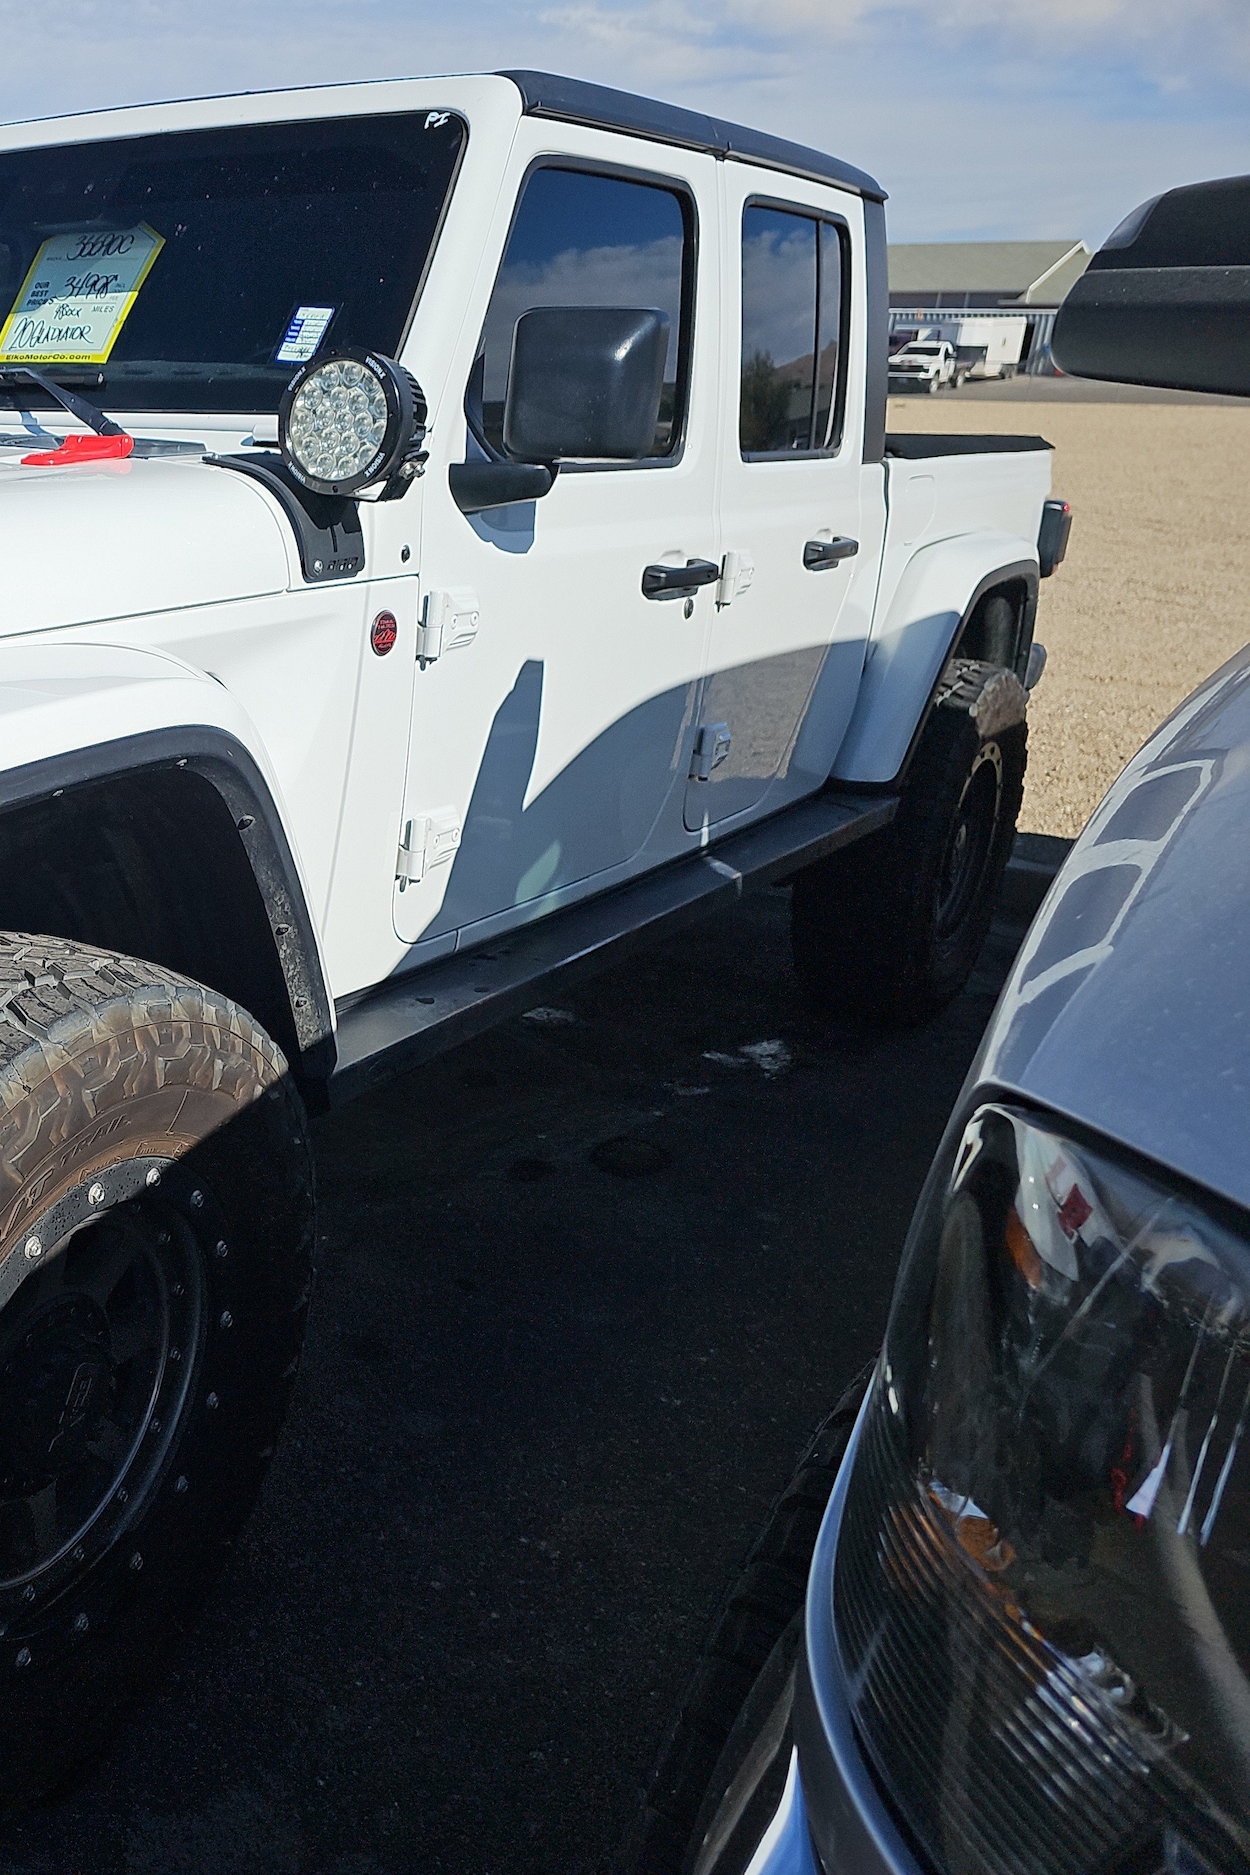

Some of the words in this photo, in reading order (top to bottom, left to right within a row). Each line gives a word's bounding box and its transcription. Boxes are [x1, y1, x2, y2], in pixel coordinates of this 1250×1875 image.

[35, 281, 50, 289] OUR
[30, 290, 50, 298] BEST
[91, 305, 115, 313] MILES
[6, 353, 91, 361] ElkoMotorCo.com
